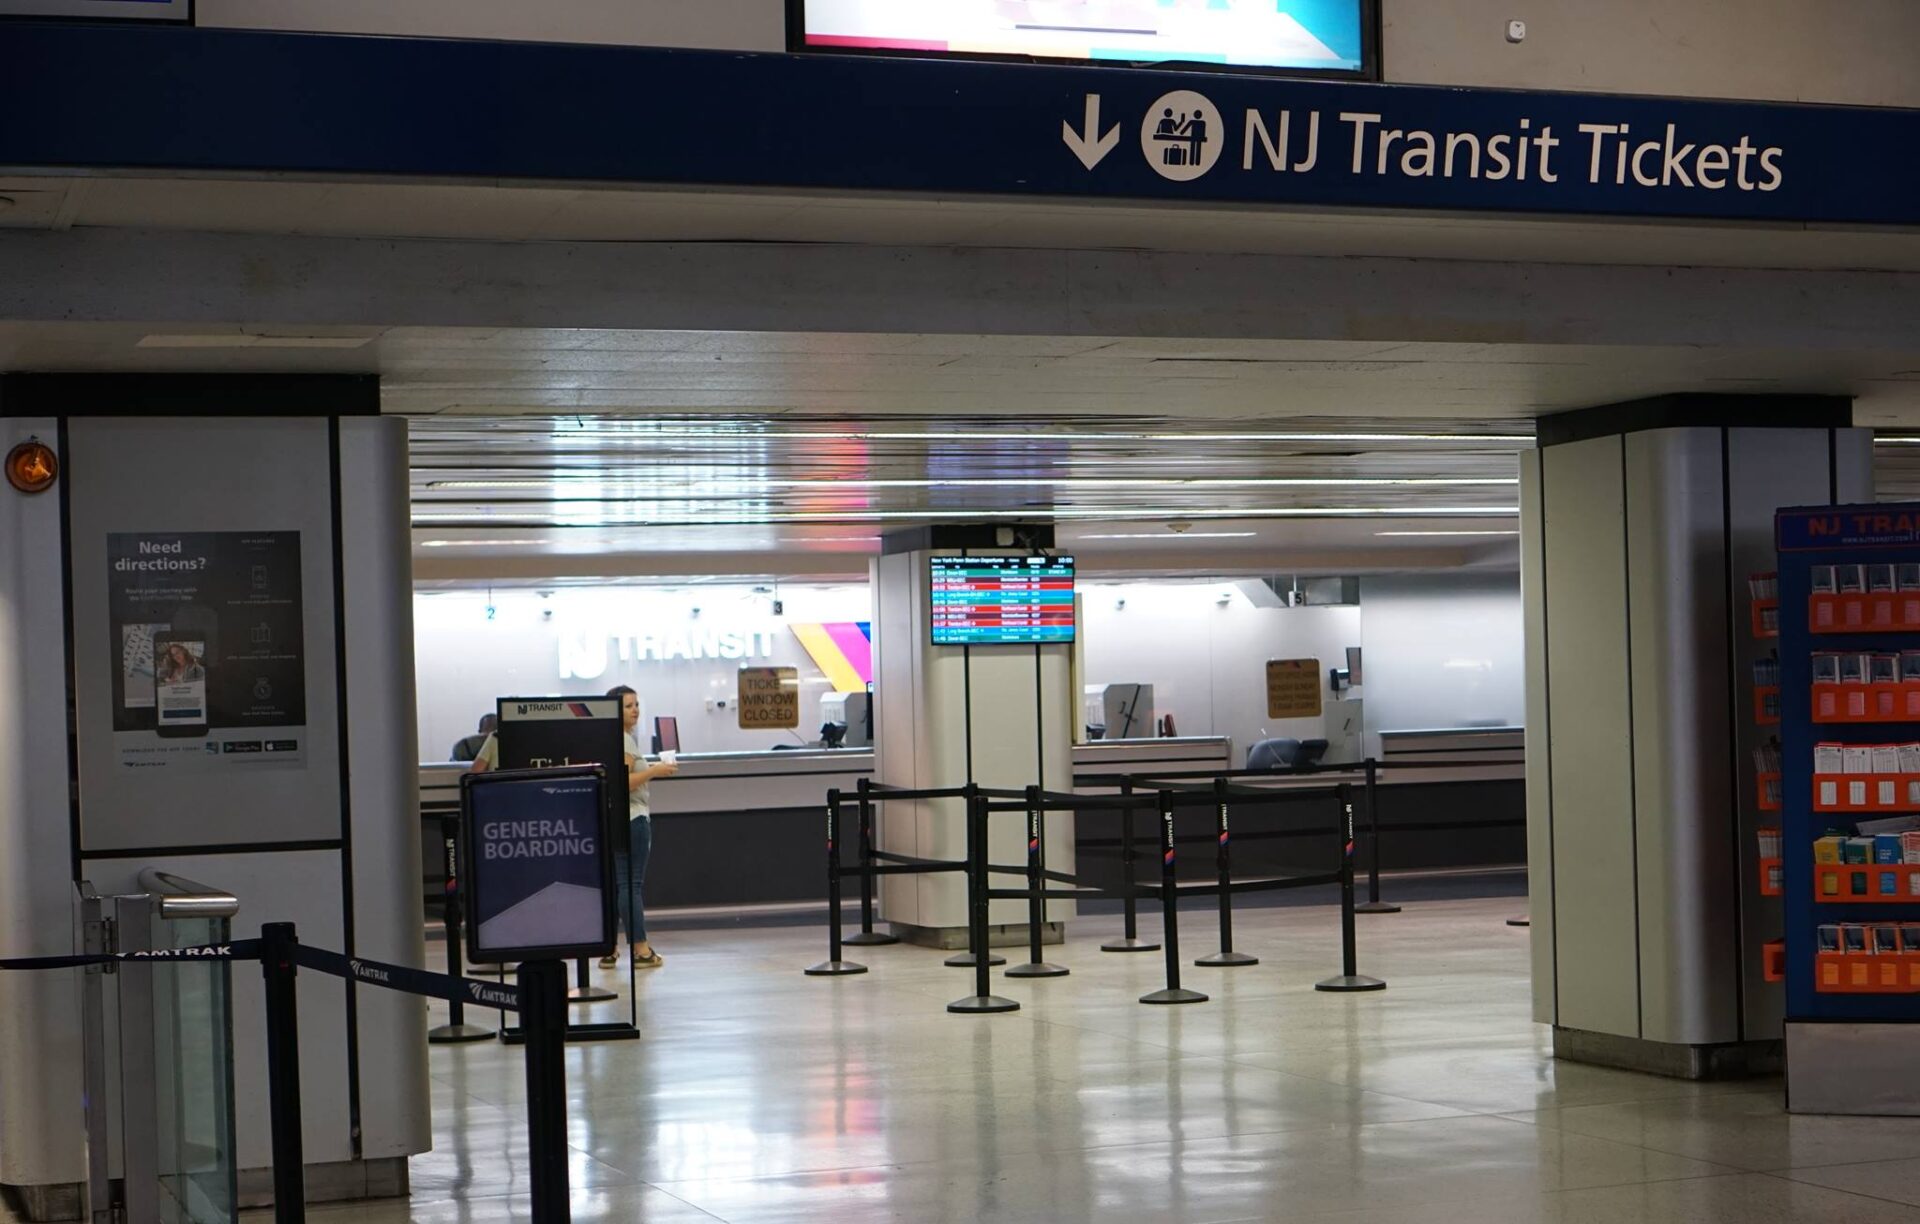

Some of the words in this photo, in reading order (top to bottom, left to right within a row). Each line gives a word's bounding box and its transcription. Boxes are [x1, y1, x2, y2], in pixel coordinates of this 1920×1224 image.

[1242, 108, 1320, 173] NJ
[1339, 112, 1559, 183] Transit
[1578, 122, 1784, 192] Tickets
[1807, 516, 1841, 537] NJ
[138, 540, 182, 554] Need
[114, 557, 207, 571] directions?
[487, 607, 495, 619] 2
[775, 601, 783, 614] 3
[609, 629, 775, 661] TRANSIT
[742, 693, 795, 705] WINDOW
[518, 704, 528, 714] NJ
[528, 703, 563, 712] TRANSIT
[744, 708, 793, 721] CLOSED
[483, 819, 580, 840] GENERAL
[484, 837, 595, 860] BOARDING
[134, 946, 231, 957] AMTRAK
[359, 966, 389, 982] AMTRAK
[482, 990, 518, 1006] AMTRAK
